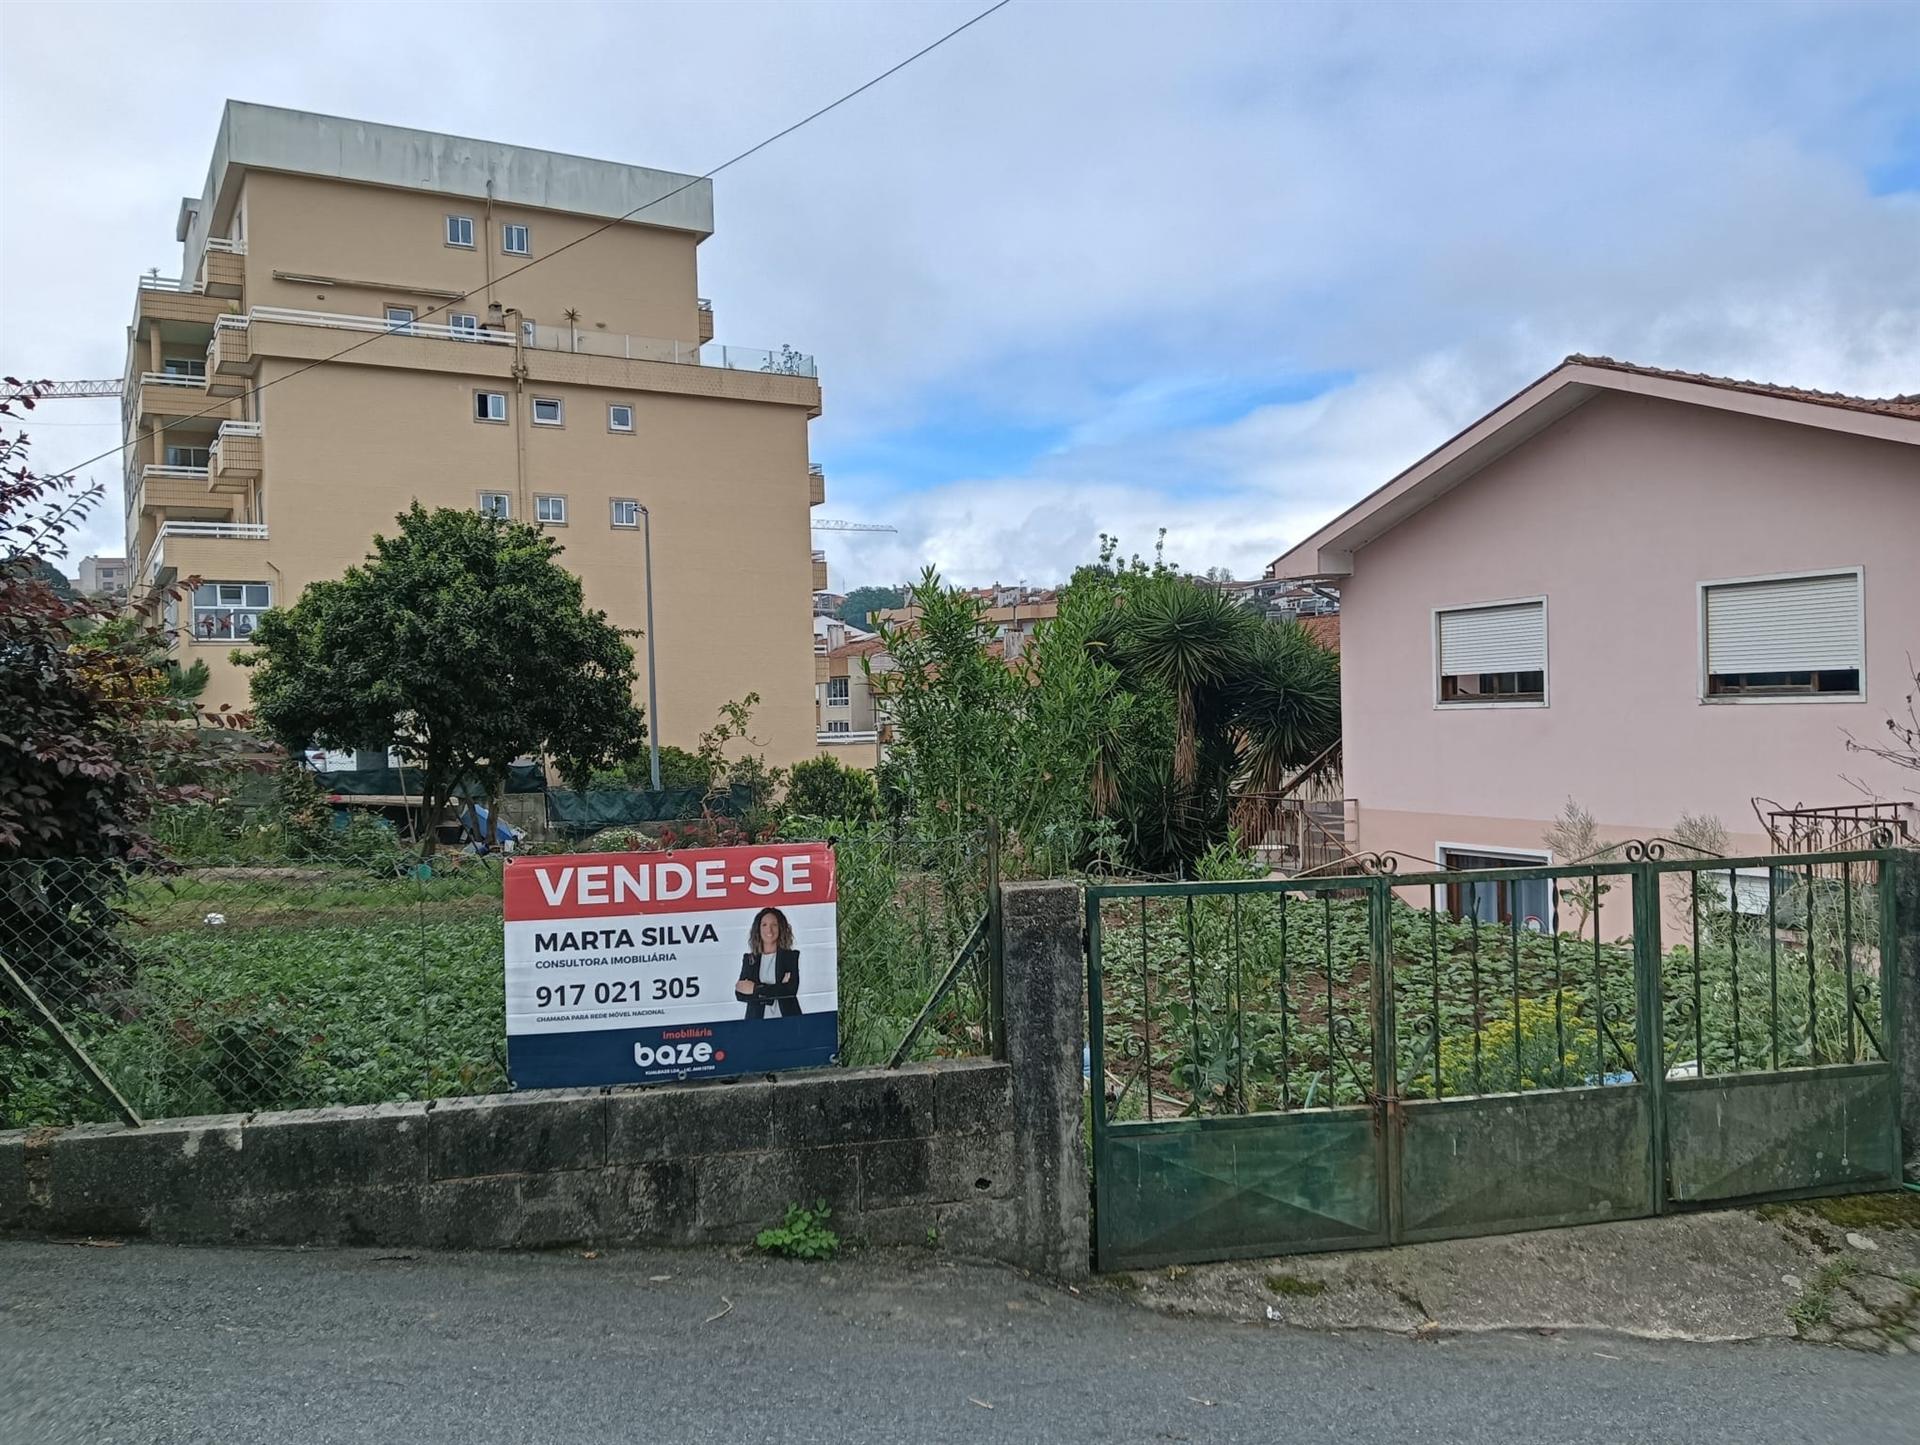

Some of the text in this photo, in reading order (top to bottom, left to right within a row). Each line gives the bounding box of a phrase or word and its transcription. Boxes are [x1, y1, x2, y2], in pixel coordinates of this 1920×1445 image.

[534, 855, 812, 906] VENDE-SE
[535, 924, 719, 952] MARTA SILVA
[535, 952, 677, 970] CONSULTORA IMOBILIÁRIA
[536, 976, 700, 1008] 917 021 305
[536, 1015, 571, 1023] CHAMADA
